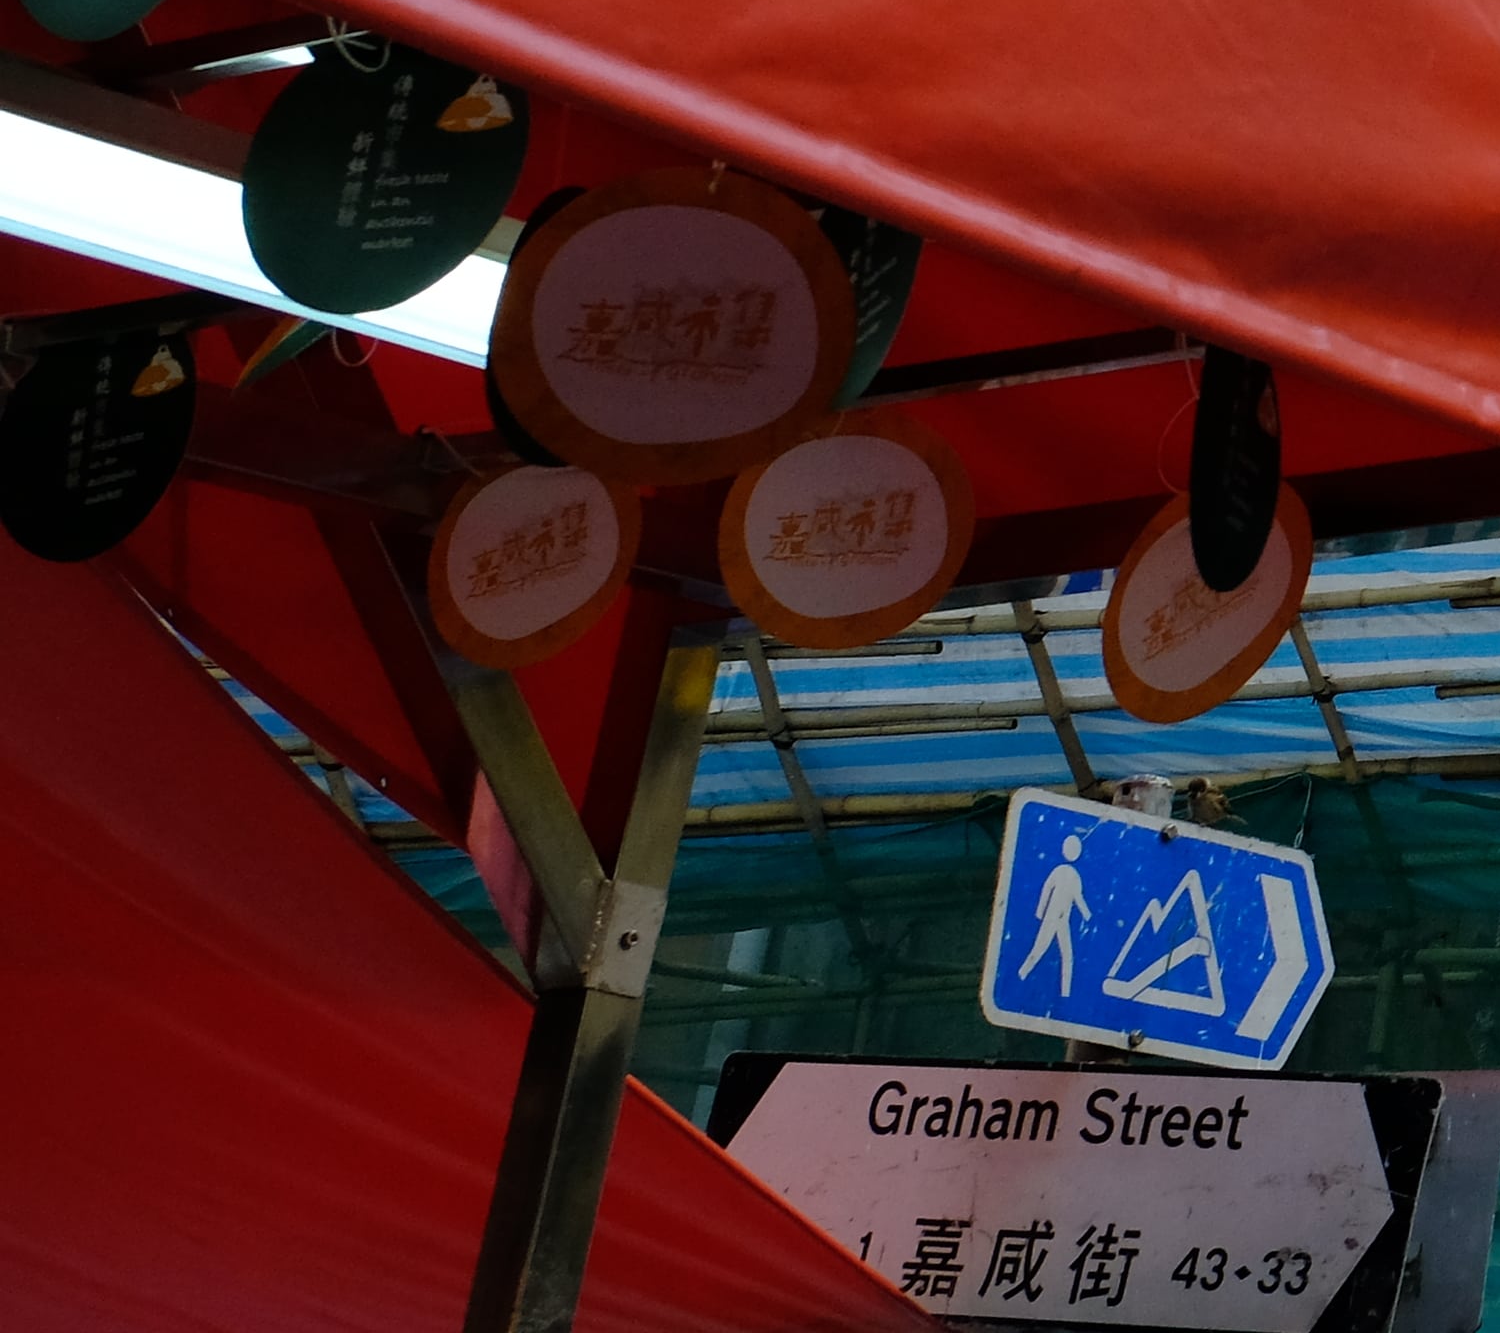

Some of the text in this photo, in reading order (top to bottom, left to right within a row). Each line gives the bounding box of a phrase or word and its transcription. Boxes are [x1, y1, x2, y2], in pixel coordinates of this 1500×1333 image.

[868, 1079, 1250, 1151] Graham Street
[900, 1217, 1142, 1308] 嘉咸街
